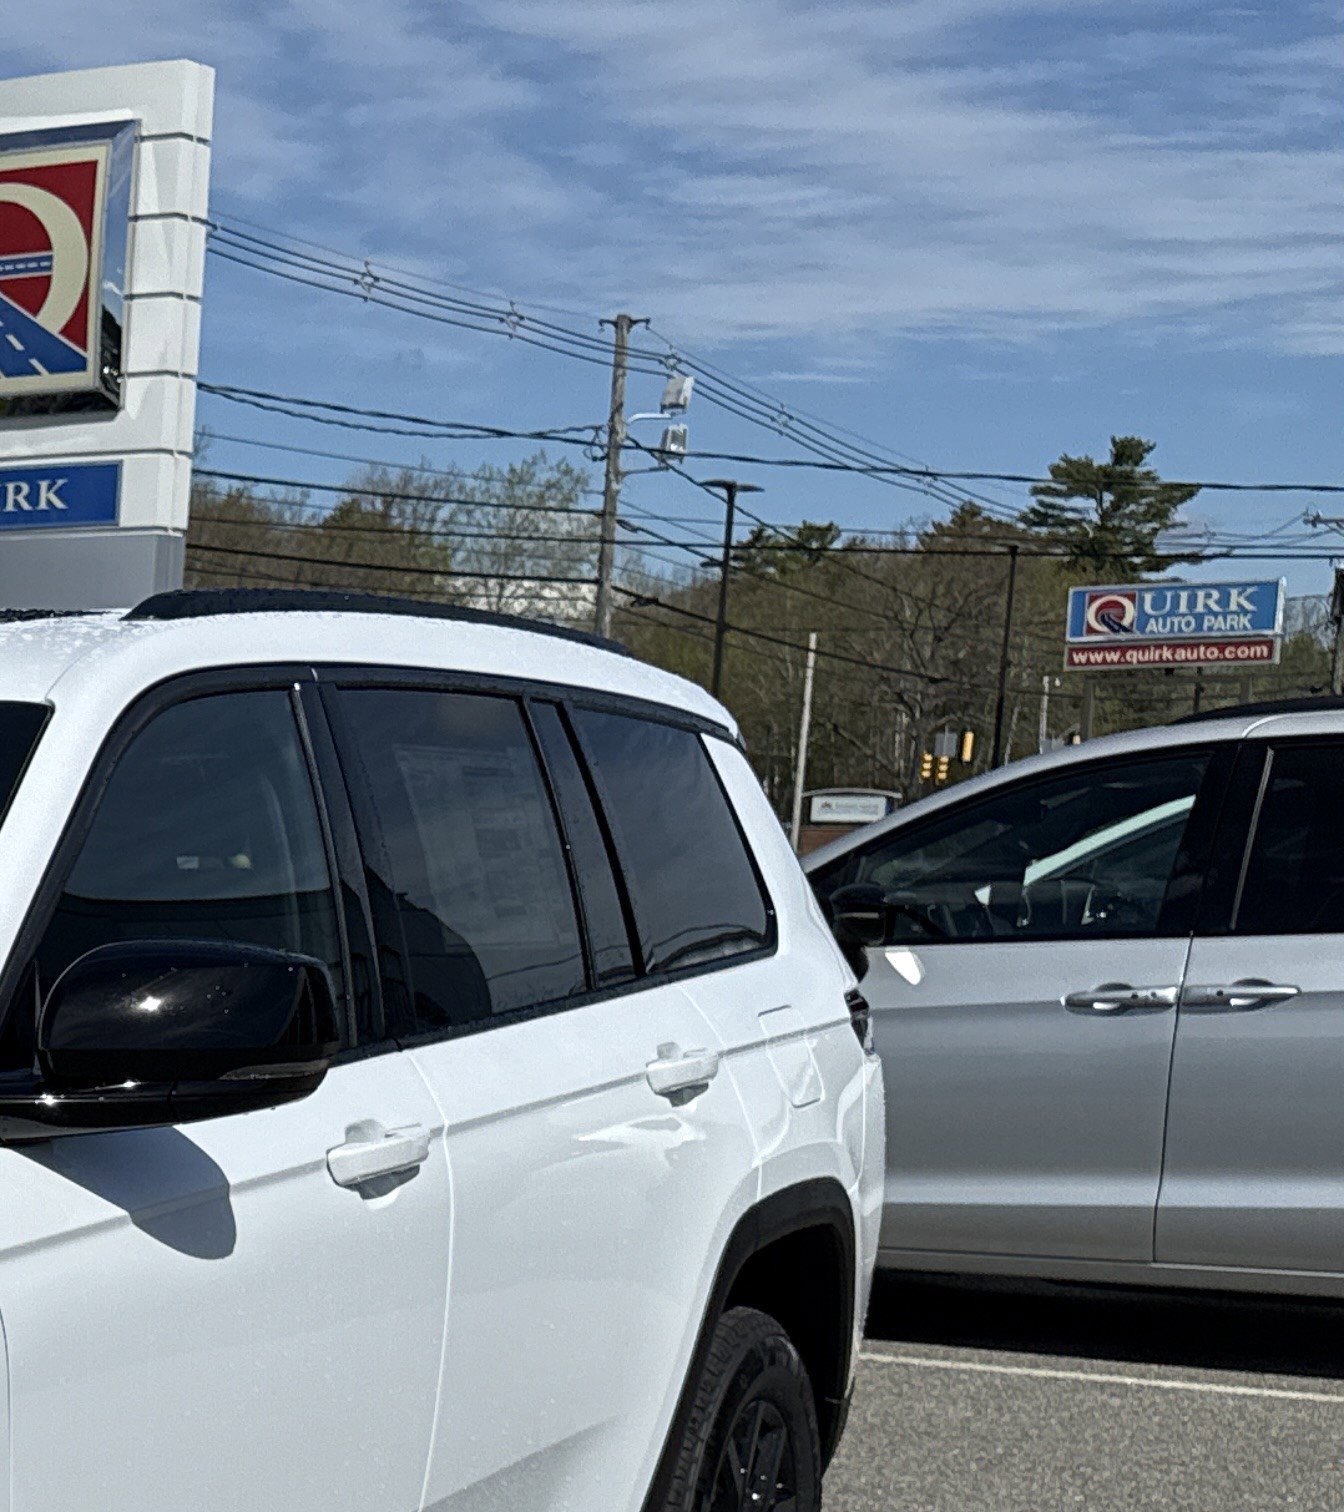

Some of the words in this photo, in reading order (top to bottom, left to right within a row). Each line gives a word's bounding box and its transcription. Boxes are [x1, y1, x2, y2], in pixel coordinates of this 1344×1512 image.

[1145, 614, 1196, 634] AUTO
[1203, 613, 1252, 632] PARK
[1072, 643, 1269, 664] www.quirkauto.com
